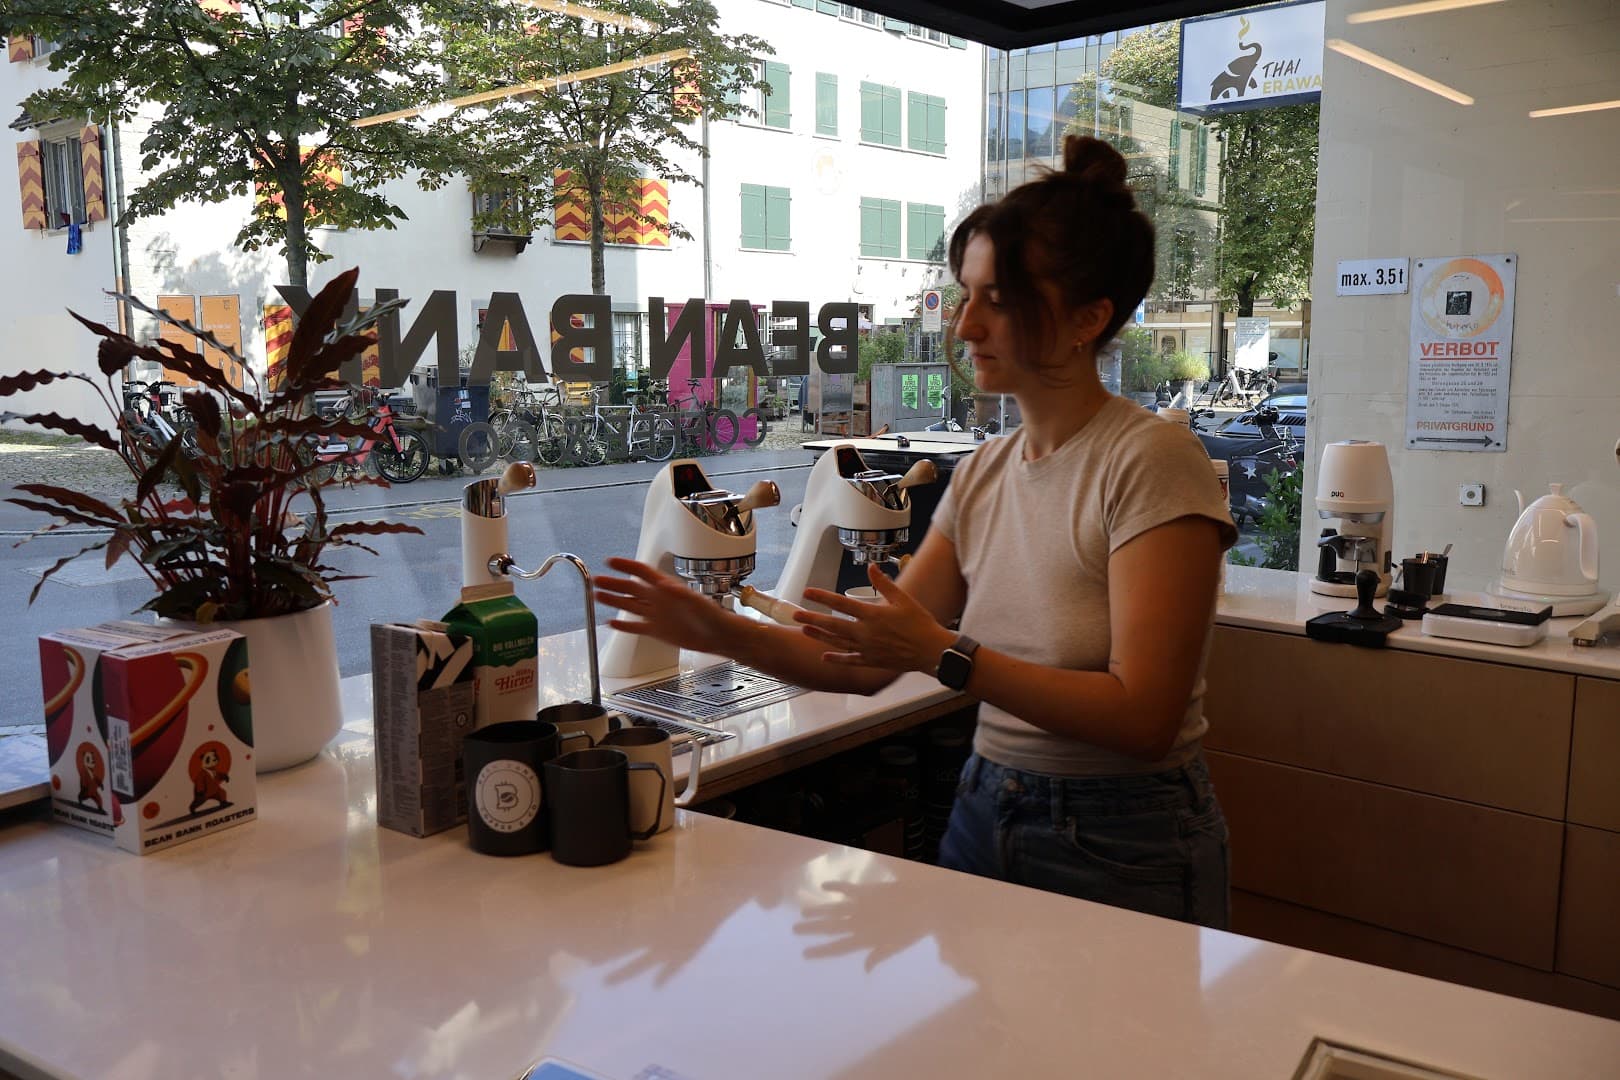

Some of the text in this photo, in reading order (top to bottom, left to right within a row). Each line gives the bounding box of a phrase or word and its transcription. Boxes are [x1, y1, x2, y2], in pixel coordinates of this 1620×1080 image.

[1262, 58, 1301, 78] THAI
[1341, 273, 1371, 287] max.
[1420, 341, 1499, 356] VERBOT
[1416, 421, 1494, 432] PRIVATGRUND
[144, 807, 256, 848] BEAN BANK ROASTERS
